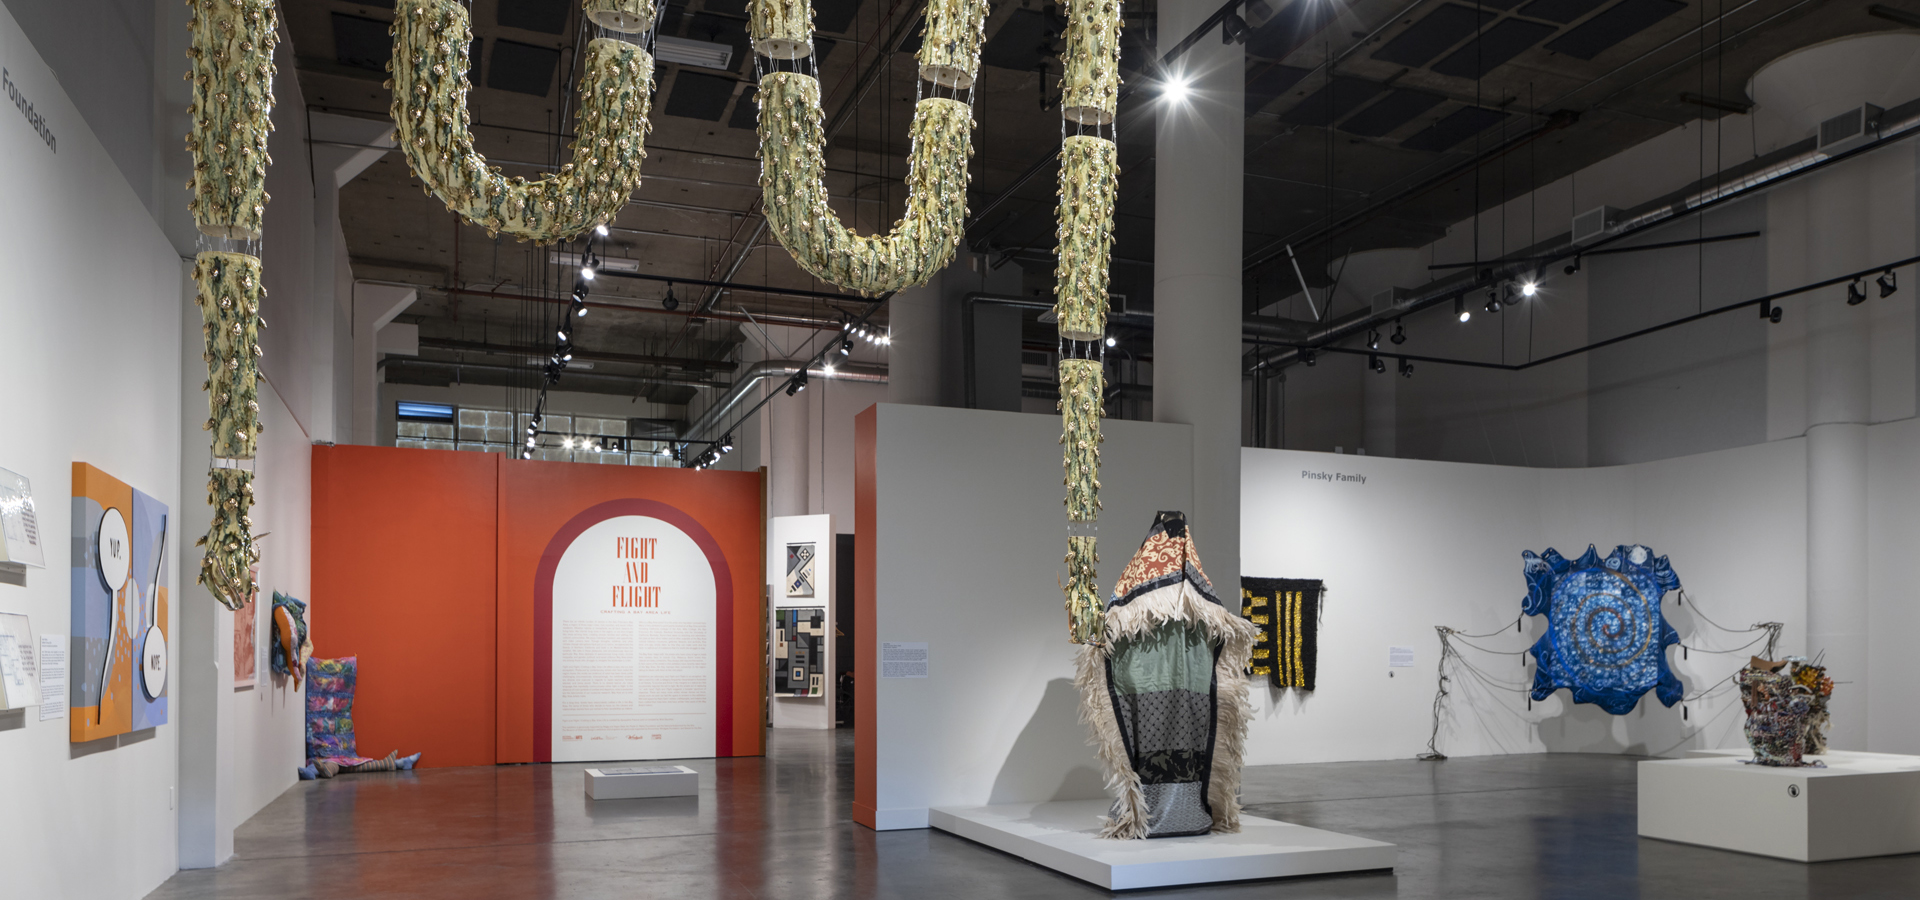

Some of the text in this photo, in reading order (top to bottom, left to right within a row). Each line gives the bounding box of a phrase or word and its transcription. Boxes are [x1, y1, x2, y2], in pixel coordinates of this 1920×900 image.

[2, 66, 57, 154] Foundation
[1301, 470, 1367, 485] Pinsky Family
[109, 537, 122, 560] YUP.
[617, 536, 657, 559] FIGHT
[622, 561, 648, 583] AND
[612, 585, 661, 607] FLIGHT
[150, 654, 162, 672] NOPE.
